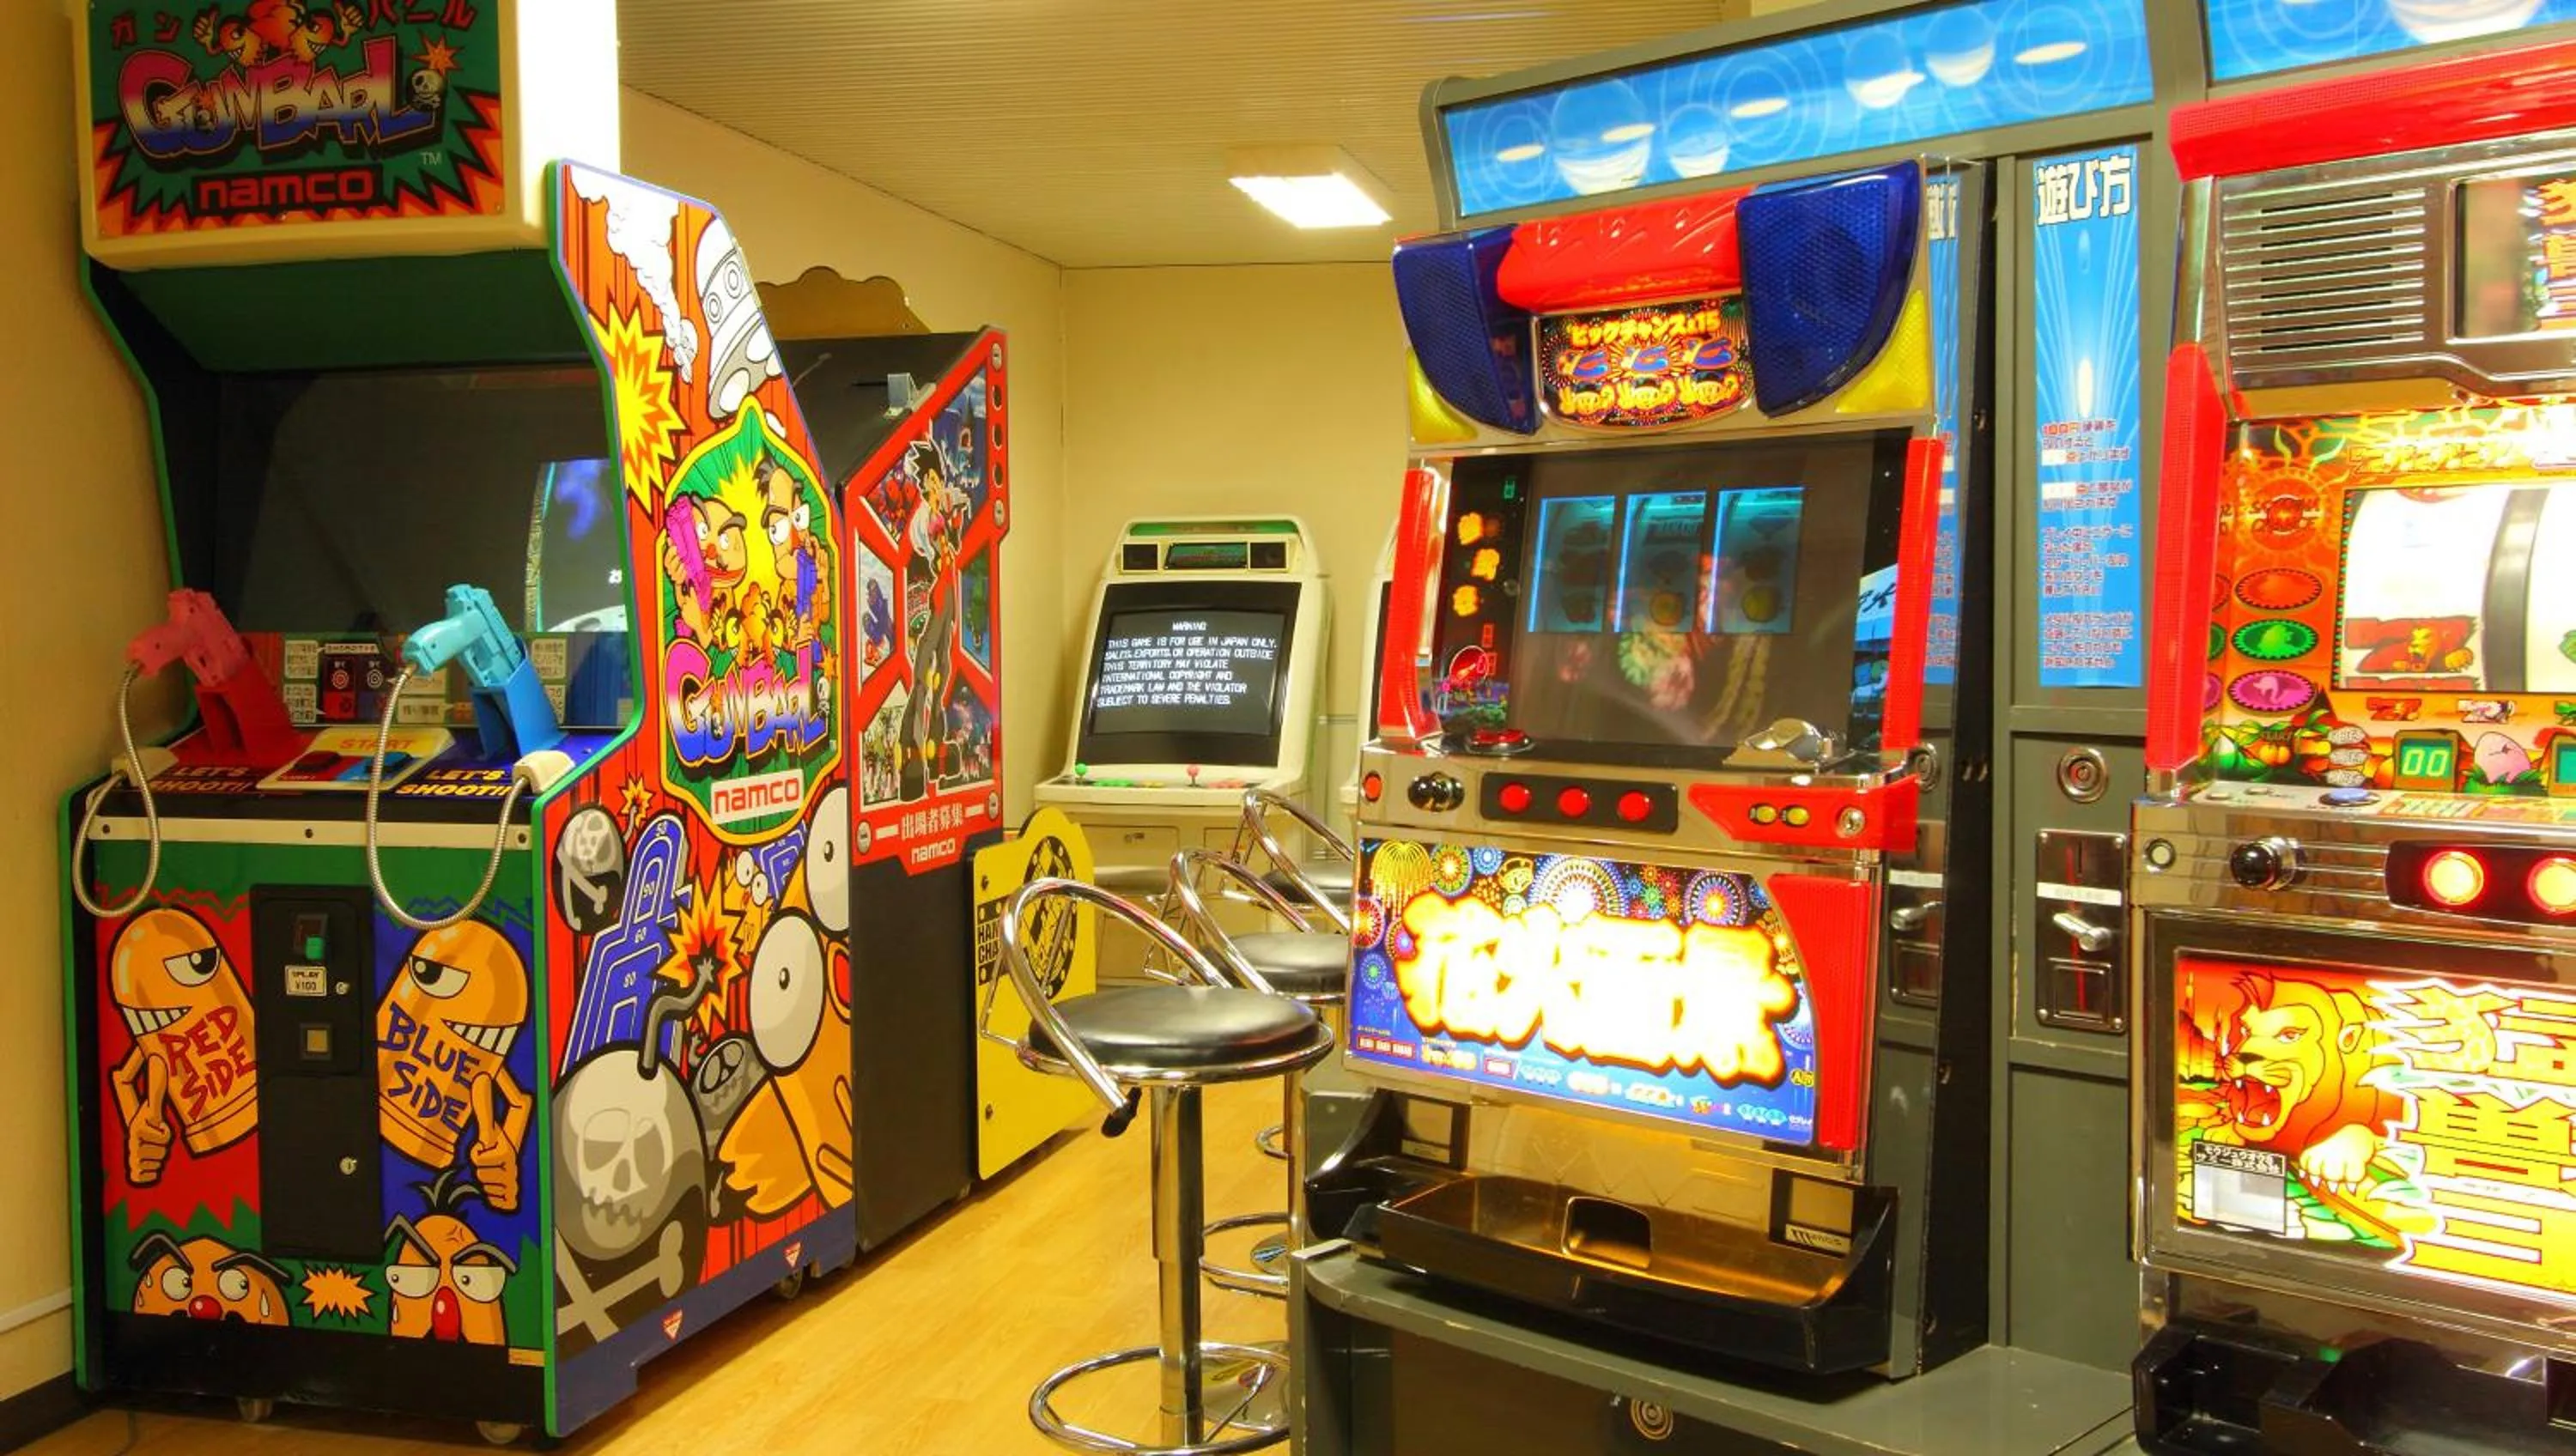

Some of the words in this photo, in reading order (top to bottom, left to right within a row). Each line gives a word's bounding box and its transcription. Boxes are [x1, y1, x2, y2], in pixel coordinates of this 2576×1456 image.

[199, 171, 376, 211] namco
[2037, 155, 2131, 226] 遊び方
[1173, 622, 1207, 631] WARNING
[1109, 639, 1129, 648] THIS
[1132, 638, 1151, 646] GAME
[1157, 637, 1167, 646] IS
[1170, 637, 1185, 646] FOR
[1188, 637, 1204, 646] USE
[1209, 637, 1218, 646] IN
[1221, 638, 1249, 646] JAPAN
[1187, 648, 1230, 658] OPERATION
[1234, 649, 1274, 659] OUTSIDE
[1102, 671, 1164, 682] INTERNATIONAL
[1169, 671, 1212, 681] COPYRIGHT
[1216, 671, 1232, 680] AND
[1104, 662, 1124, 671] THIS
[1128, 660, 1171, 670] TERRITORY
[1176, 659, 1190, 669] MAY
[1194, 659, 1228, 669] VIOLATE
[1097, 695, 1133, 707] SUBJECT
[1138, 695, 1147, 704] TO
[1151, 695, 1182, 704] SEVERE
[1100, 684, 1145, 695] TRADEMARK
[1148, 683, 1163, 692] LAW
[1167, 682, 1184, 692] AND
[1188, 682, 1201, 692] THE
[1205, 683, 1248, 694] VIOLATOR
[424, 769, 506, 781] LET'S
[2402, 749, 2450, 777] 00
[714, 776, 801, 816] namco
[902, 803, 963, 841] 出場者募集
[910, 837, 956, 864] namco
[160, 1004, 239, 1077] RED
[379, 1000, 481, 1089] BLUE
[179, 1057, 257, 1120] SIDE
[387, 1061, 471, 1133] SIDE
